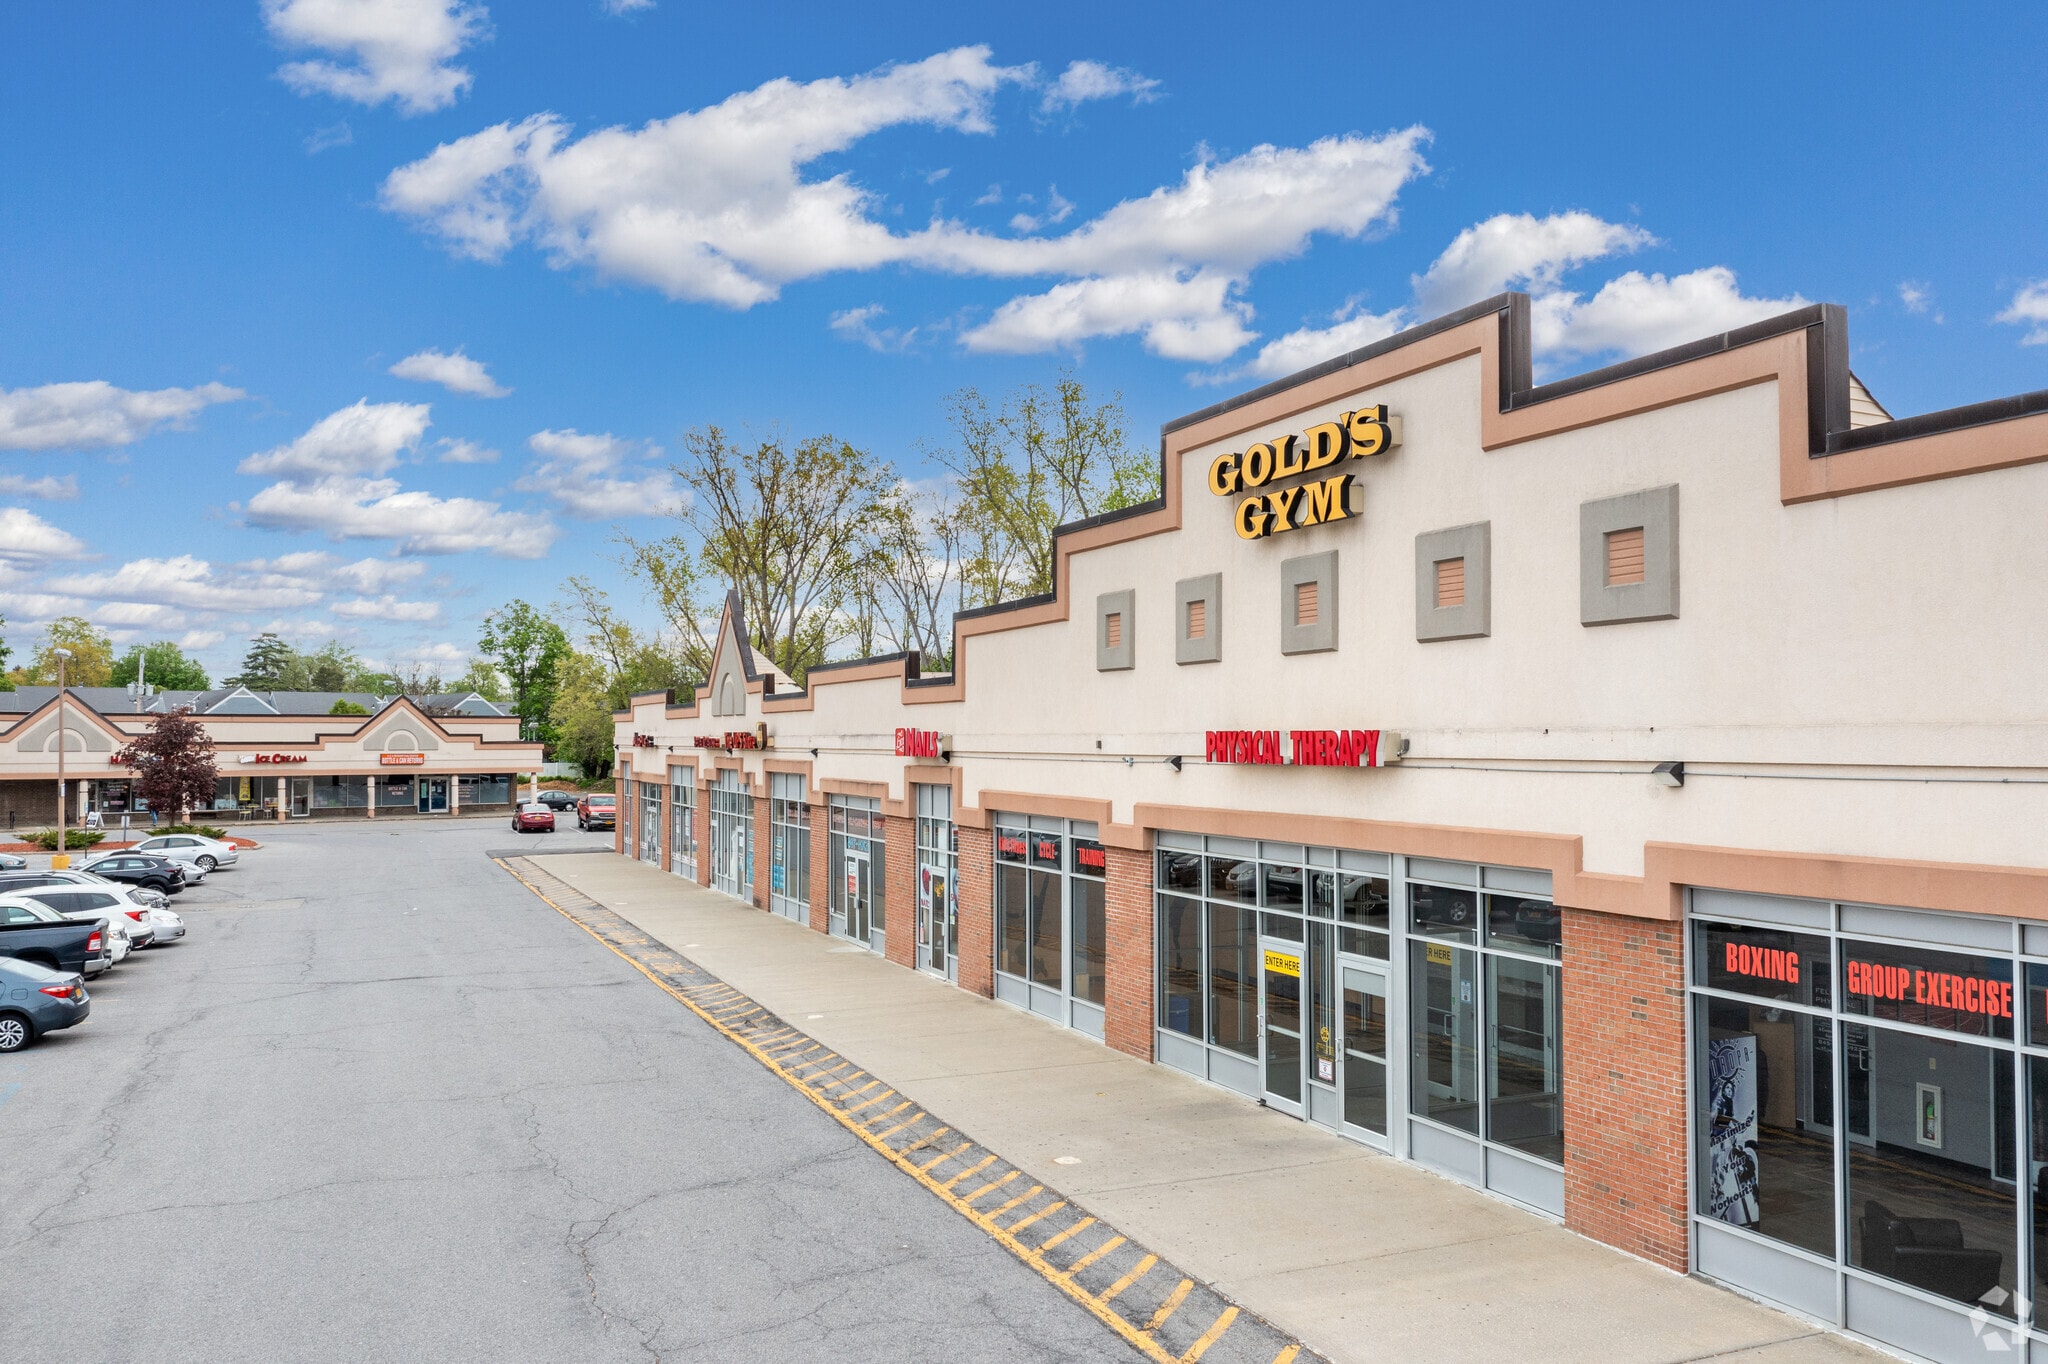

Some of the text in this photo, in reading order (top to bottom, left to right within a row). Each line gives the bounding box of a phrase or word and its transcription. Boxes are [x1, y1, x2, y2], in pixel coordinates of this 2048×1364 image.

[1208, 404, 1391, 496] GOLD'S
[1235, 474, 1355, 539] GYM
[906, 728, 941, 758] NAILS
[1206, 730, 1383, 768] PHYSICAL THERAPY
[272, 753, 307, 764] CREAM
[1039, 842, 1055, 859] CYCLE
[1079, 848, 1104, 867] TRAINING
[1265, 955, 1300, 972] ENTER HERE
[1433, 945, 1451, 961] HERE
[1725, 942, 1799, 984] BOXING
[1848, 960, 1910, 1001] GROUP
[1915, 969, 2012, 1018] EXERCISE
[1723, 1156, 1746, 1173] Your
